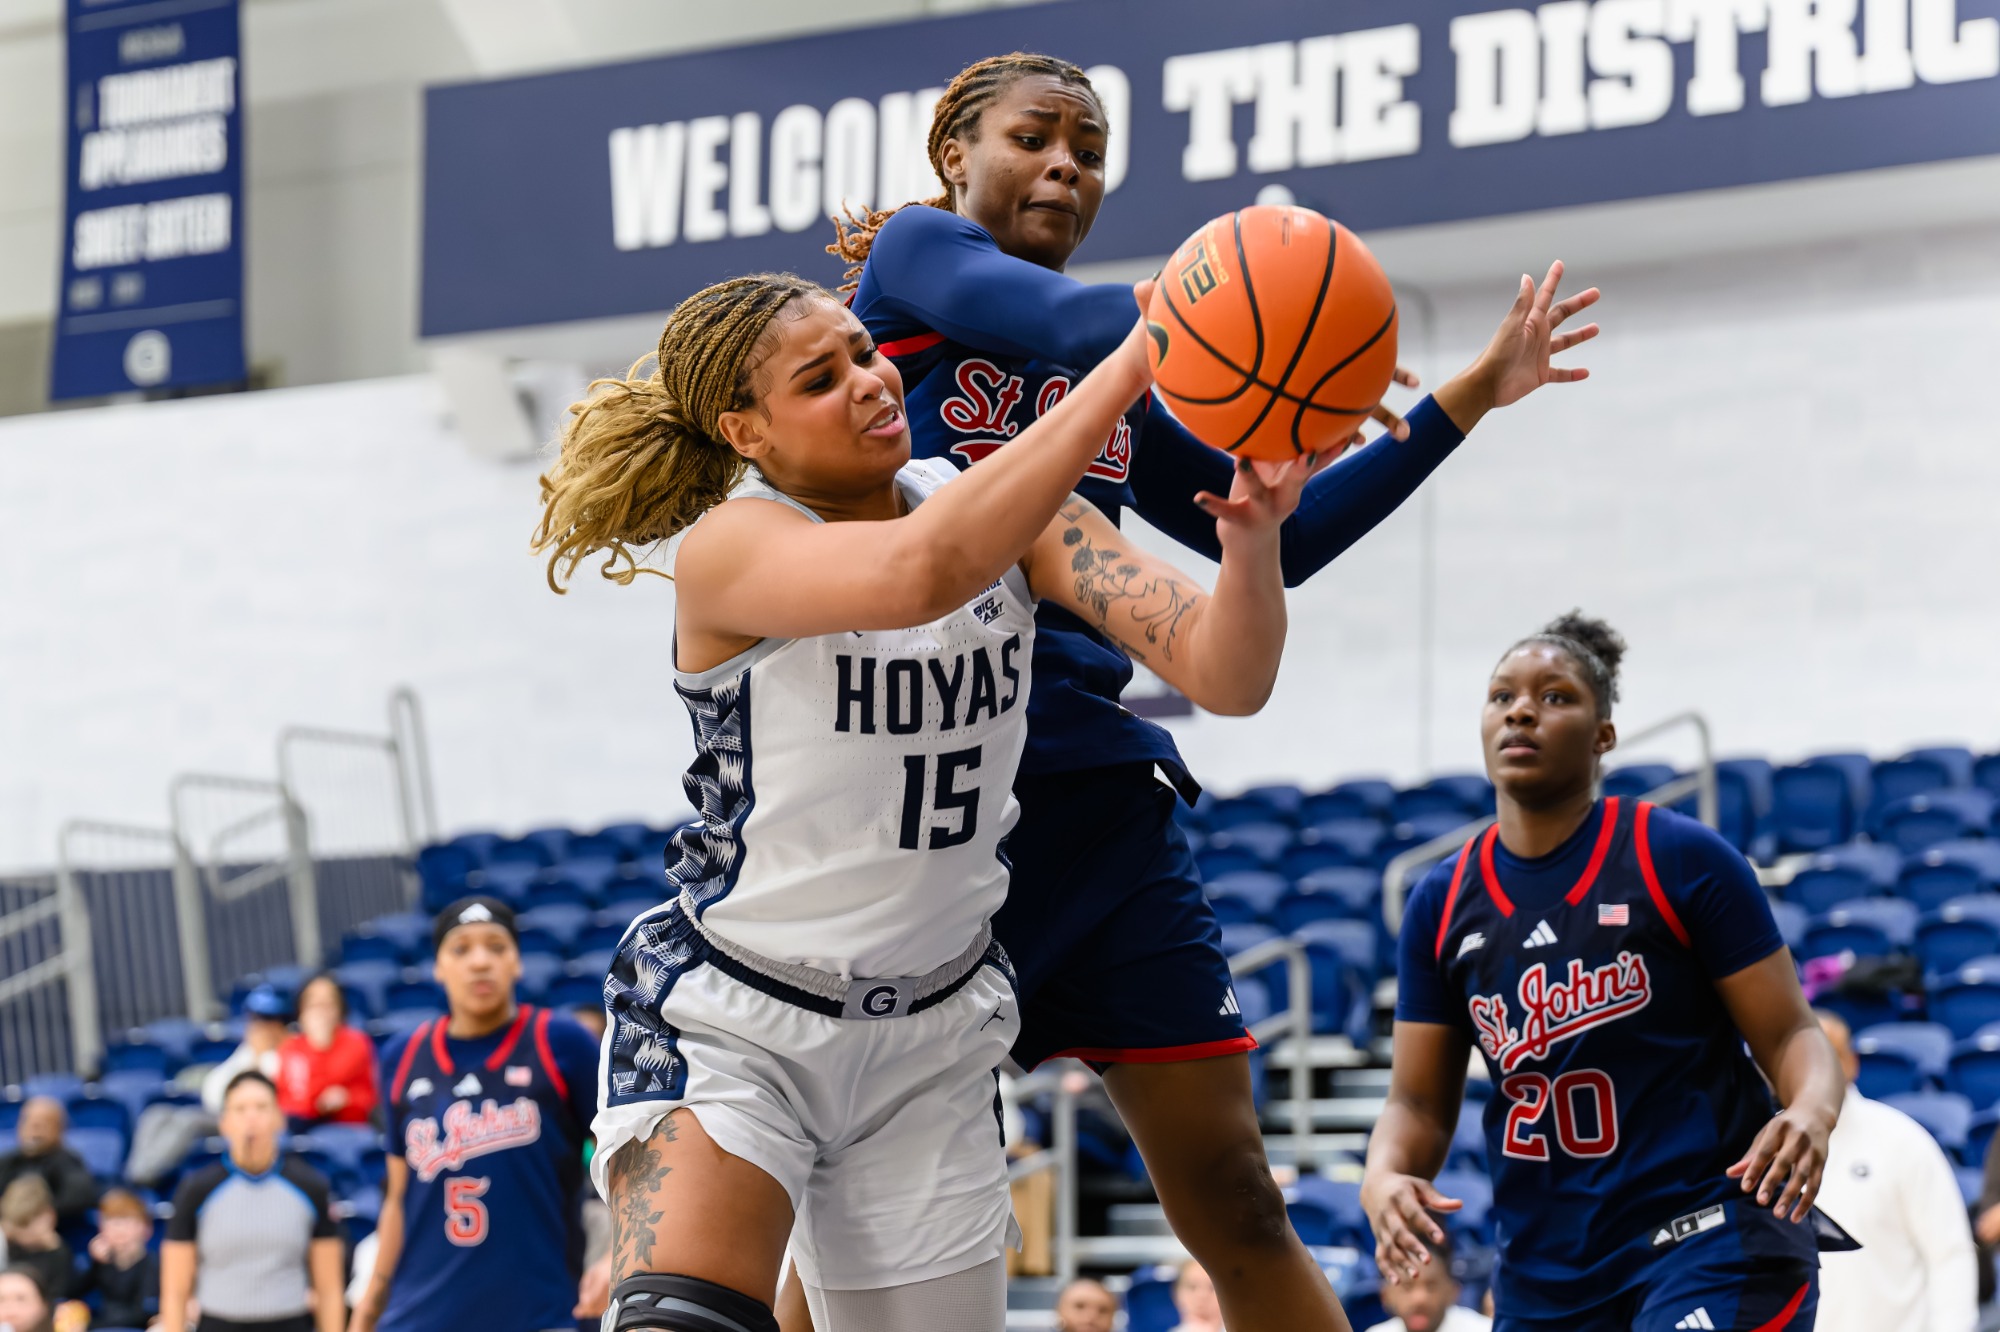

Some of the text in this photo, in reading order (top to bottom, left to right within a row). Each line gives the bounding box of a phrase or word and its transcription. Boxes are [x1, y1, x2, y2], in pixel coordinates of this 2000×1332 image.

[608, 86, 948, 252] WELCOM
[1162, 22, 1421, 182] THE
[940, 358, 1024, 437] St.
[973, 596, 995, 617] BIG
[835, 632, 1021, 735] HOYAS
[899, 744, 983, 850] 15
[860, 984, 901, 1018] G
[1468, 950, 1653, 1074] St. John's
[1501, 1068, 1619, 1162] 20
[443, 1176, 492, 1248] 5
